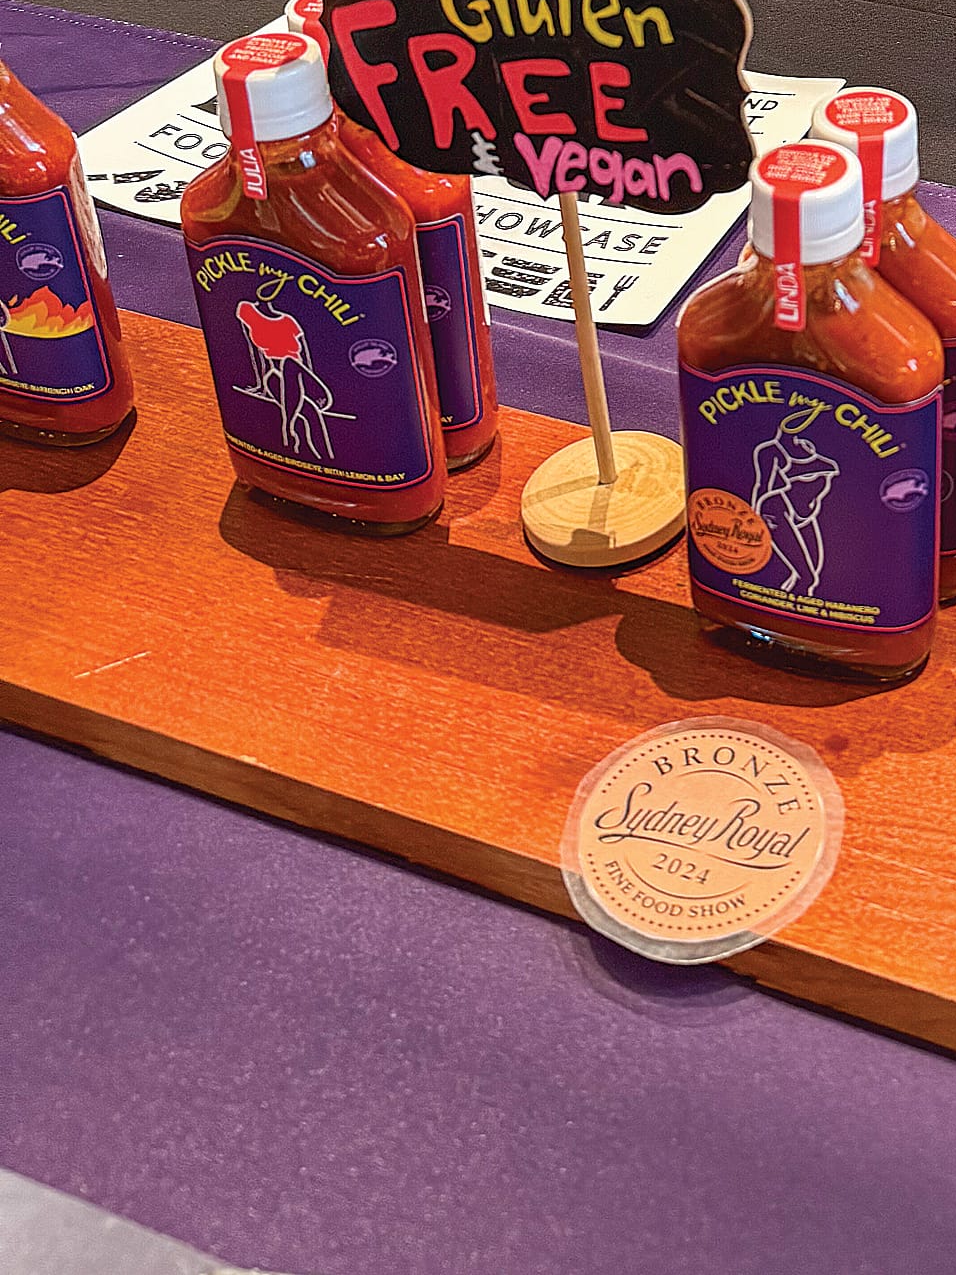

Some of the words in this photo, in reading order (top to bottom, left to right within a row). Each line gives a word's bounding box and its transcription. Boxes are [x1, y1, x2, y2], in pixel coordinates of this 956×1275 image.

[149, 123, 231, 160] FOO
[240, 147, 264, 196] JULIA
[476, 205, 669, 255] HOWASE
[195, 251, 256, 292] PICKLE
[776, 263, 799, 322] LINDA
[699, 380, 785, 425] PICKLE
[650, 745, 802, 816] BRONZE
[594, 781, 718, 847] Sydney
[711, 797, 811, 861] Royal
[604, 859, 637, 895] FINE
[631, 890, 684, 918] FOOD
[685, 892, 748, 919] SHOW
[651, 853, 711, 886] 2024
